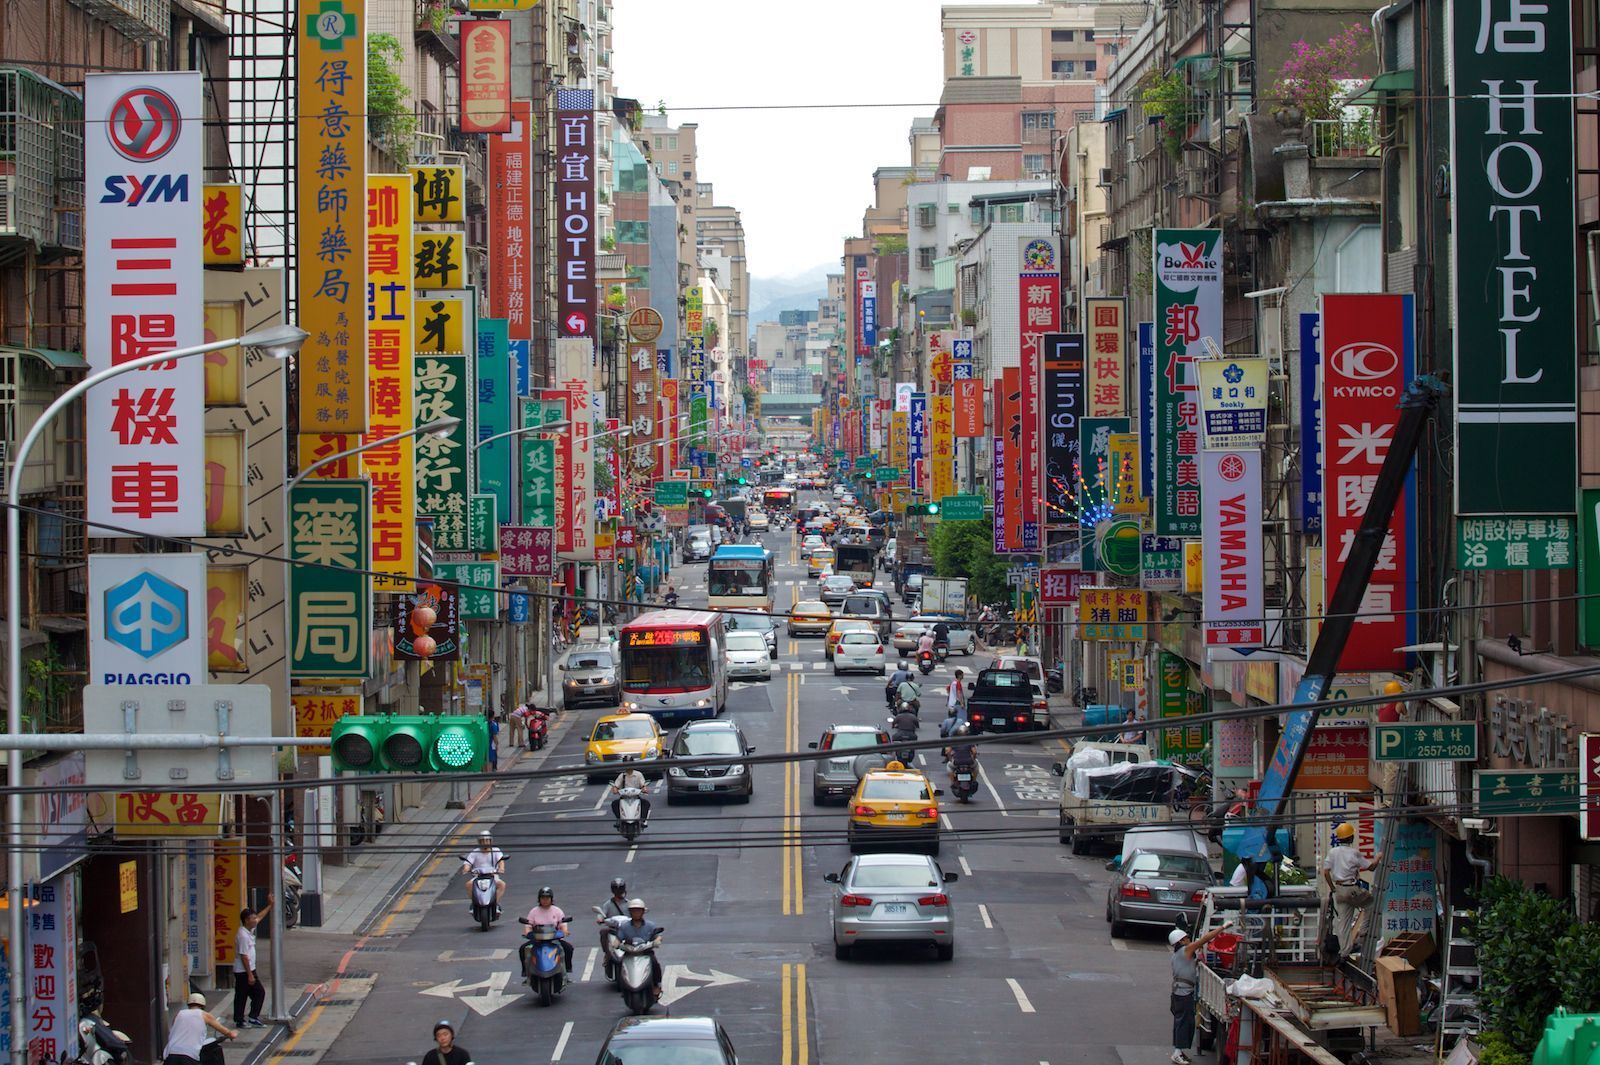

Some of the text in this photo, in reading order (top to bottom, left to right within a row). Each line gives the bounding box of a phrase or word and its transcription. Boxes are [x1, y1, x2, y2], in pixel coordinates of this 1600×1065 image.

[99, 174, 189, 207] SYM
[313, 60, 353, 305] 得意藥師藥局
[414, 168, 459, 219] 博
[505, 152, 524, 221] 福建正德
[561, 115, 588, 303] 百宣 HOTEL
[415, 236, 459, 287] 群
[1481, 79, 1546, 385] HOTEL
[1027, 285, 1053, 326] 新階
[111, 238, 178, 519] 三陽機車
[315, 331, 333, 424] 為您服務
[1050, 342, 1081, 429] Liling
[1333, 386, 1396, 397] KYMCO
[968, 398, 976, 433] COSMED
[1166, 403, 1174, 516] Bonnie American School
[1176, 402, 1199, 515] 兒童美語
[1219, 493, 1248, 612] YAMAHA
[1463, 519, 1570, 541] 附設停車場
[293, 498, 359, 663] 藥局
[1379, 730, 1400, 757] P
[1415, 743, 1471, 757] 2557-1260
[1387, 879, 1434, 892] 小一先修
